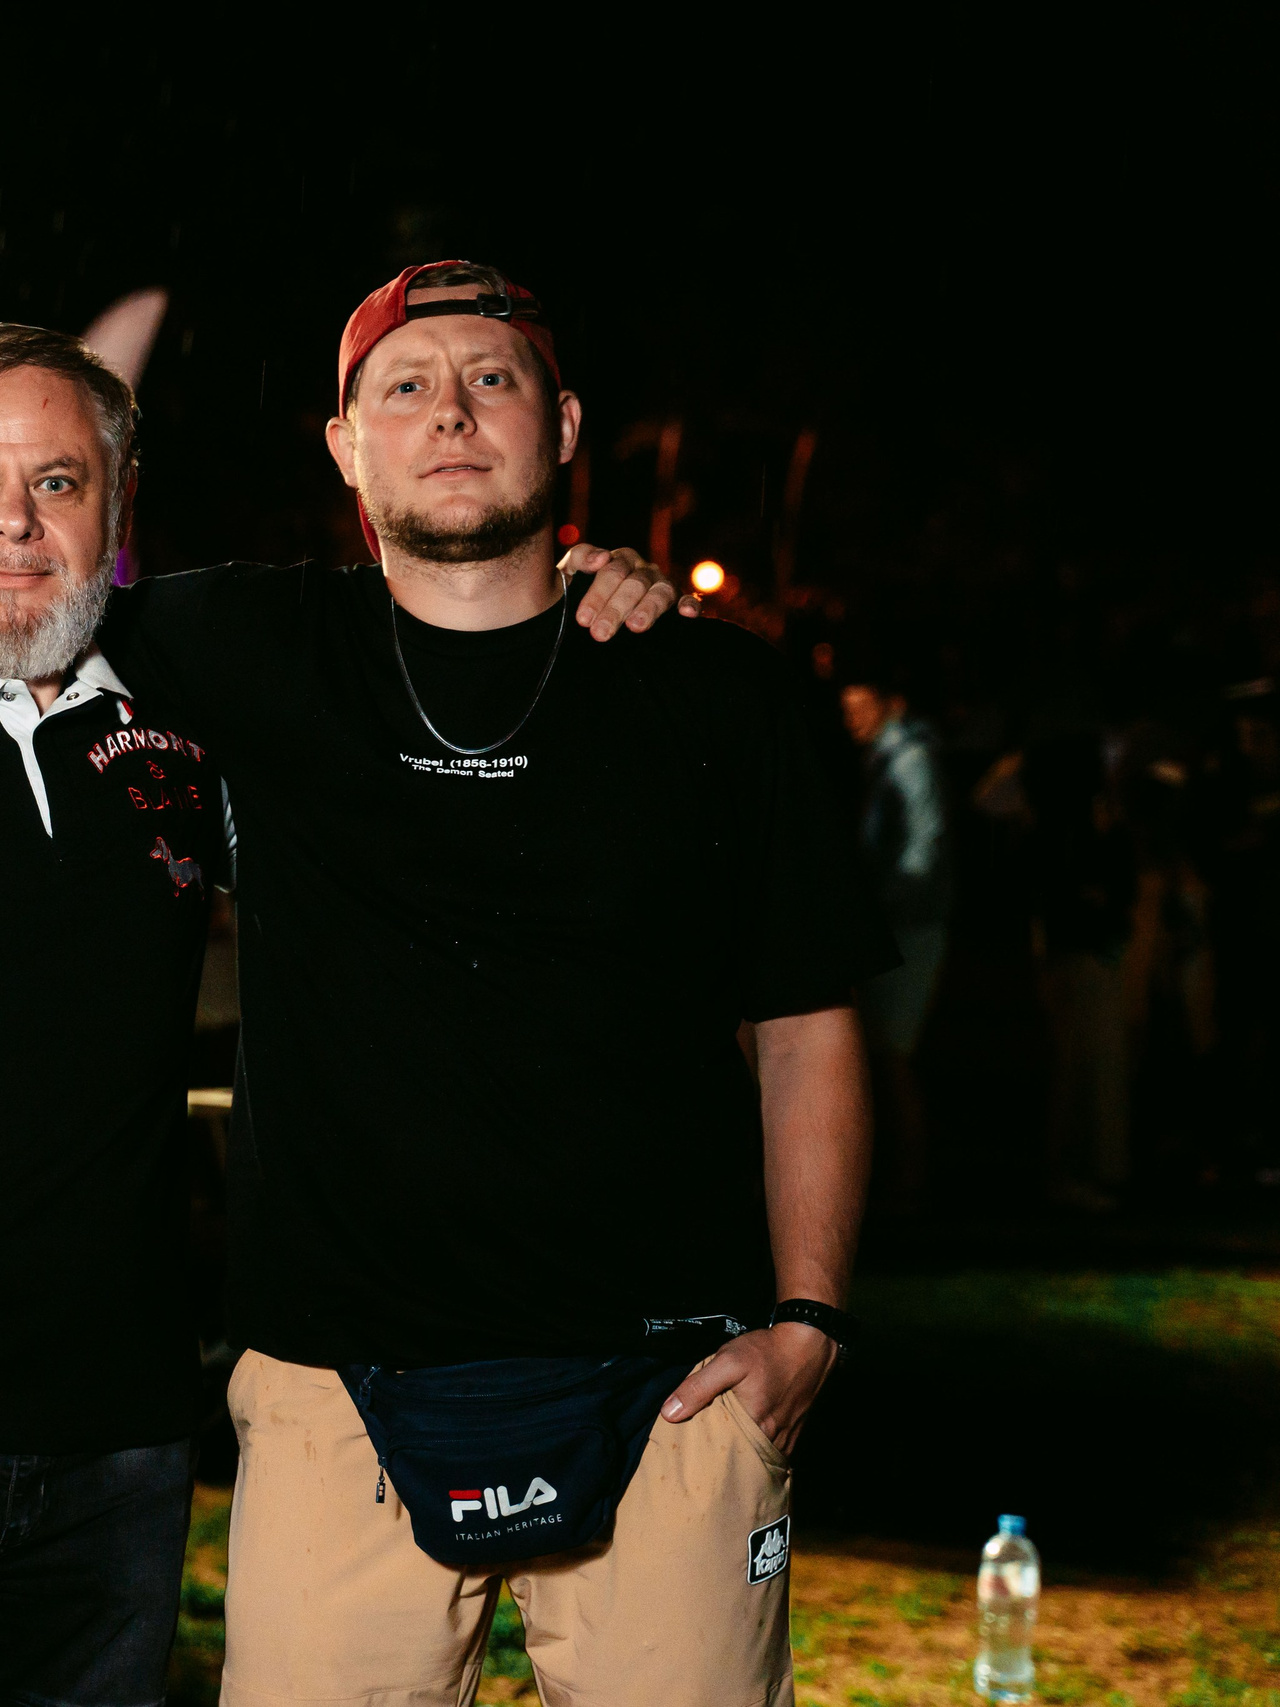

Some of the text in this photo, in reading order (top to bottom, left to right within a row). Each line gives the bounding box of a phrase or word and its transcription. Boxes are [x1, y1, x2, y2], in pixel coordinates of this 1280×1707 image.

[86, 727, 206, 774] HARMONT
[399, 753, 529, 769] Vrubel (1856-1910)
[146, 760, 167, 779] &
[412, 764, 514, 779] The Demon Seated
[128, 784, 203, 810] BLAE
[448, 1476, 558, 1523] FILA
[455, 1513, 563, 1541] ITALIAN HERITAGE
